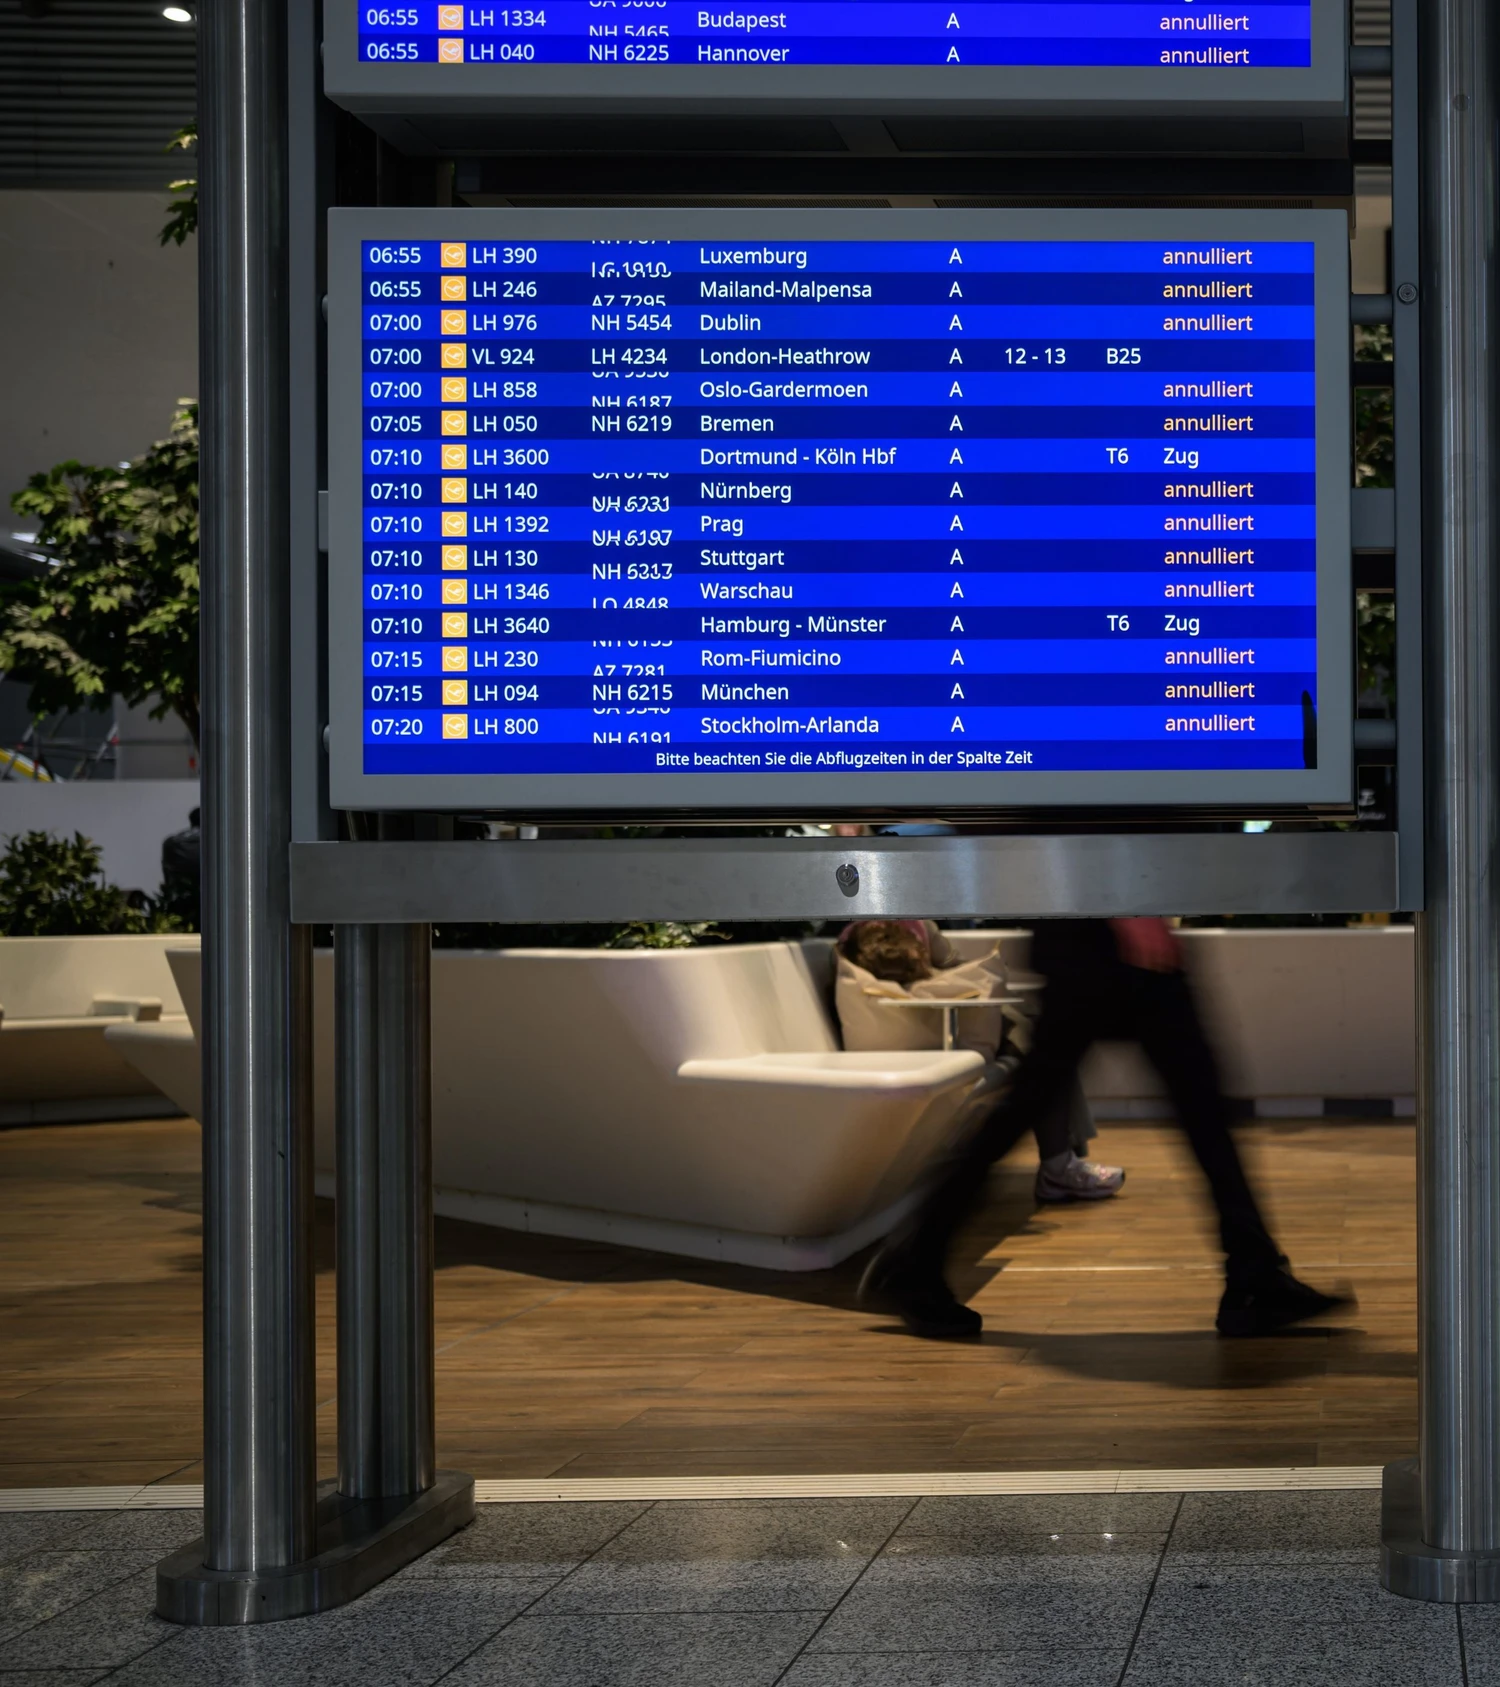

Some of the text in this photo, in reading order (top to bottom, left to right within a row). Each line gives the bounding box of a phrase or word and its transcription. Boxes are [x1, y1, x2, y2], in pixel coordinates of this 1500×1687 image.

[367, 9, 1249, 32] 06:55 LH 1334 Budapest annulliert
[368, 43, 1249, 63] 06:55 LH 040 NH 6225 Hannover annulliert
[370, 281, 1252, 302] 06:55 LH 246 Mailand-Malpensa annulliert
[371, 348, 1141, 364] 07:00 VL 924 LH 4234 London-Heathrow 12 13 B25
[371, 415, 1253, 431] 07:05 LH 050 NH 6219 Bremen annulliert
[371, 548, 1254, 570] 07:10 LH 130 Stuttgart annulliert
[372, 615, 1199, 637] 07:10 LH 3640 Hamburg Münster T6 Zug
[372, 715, 1255, 735] 07:20 LH 800 Stockholm-Arlanda annulliert
[657, 751, 1032, 768] Bitte beachten Sie die Abflugzeiten in der Spalte Zeit
